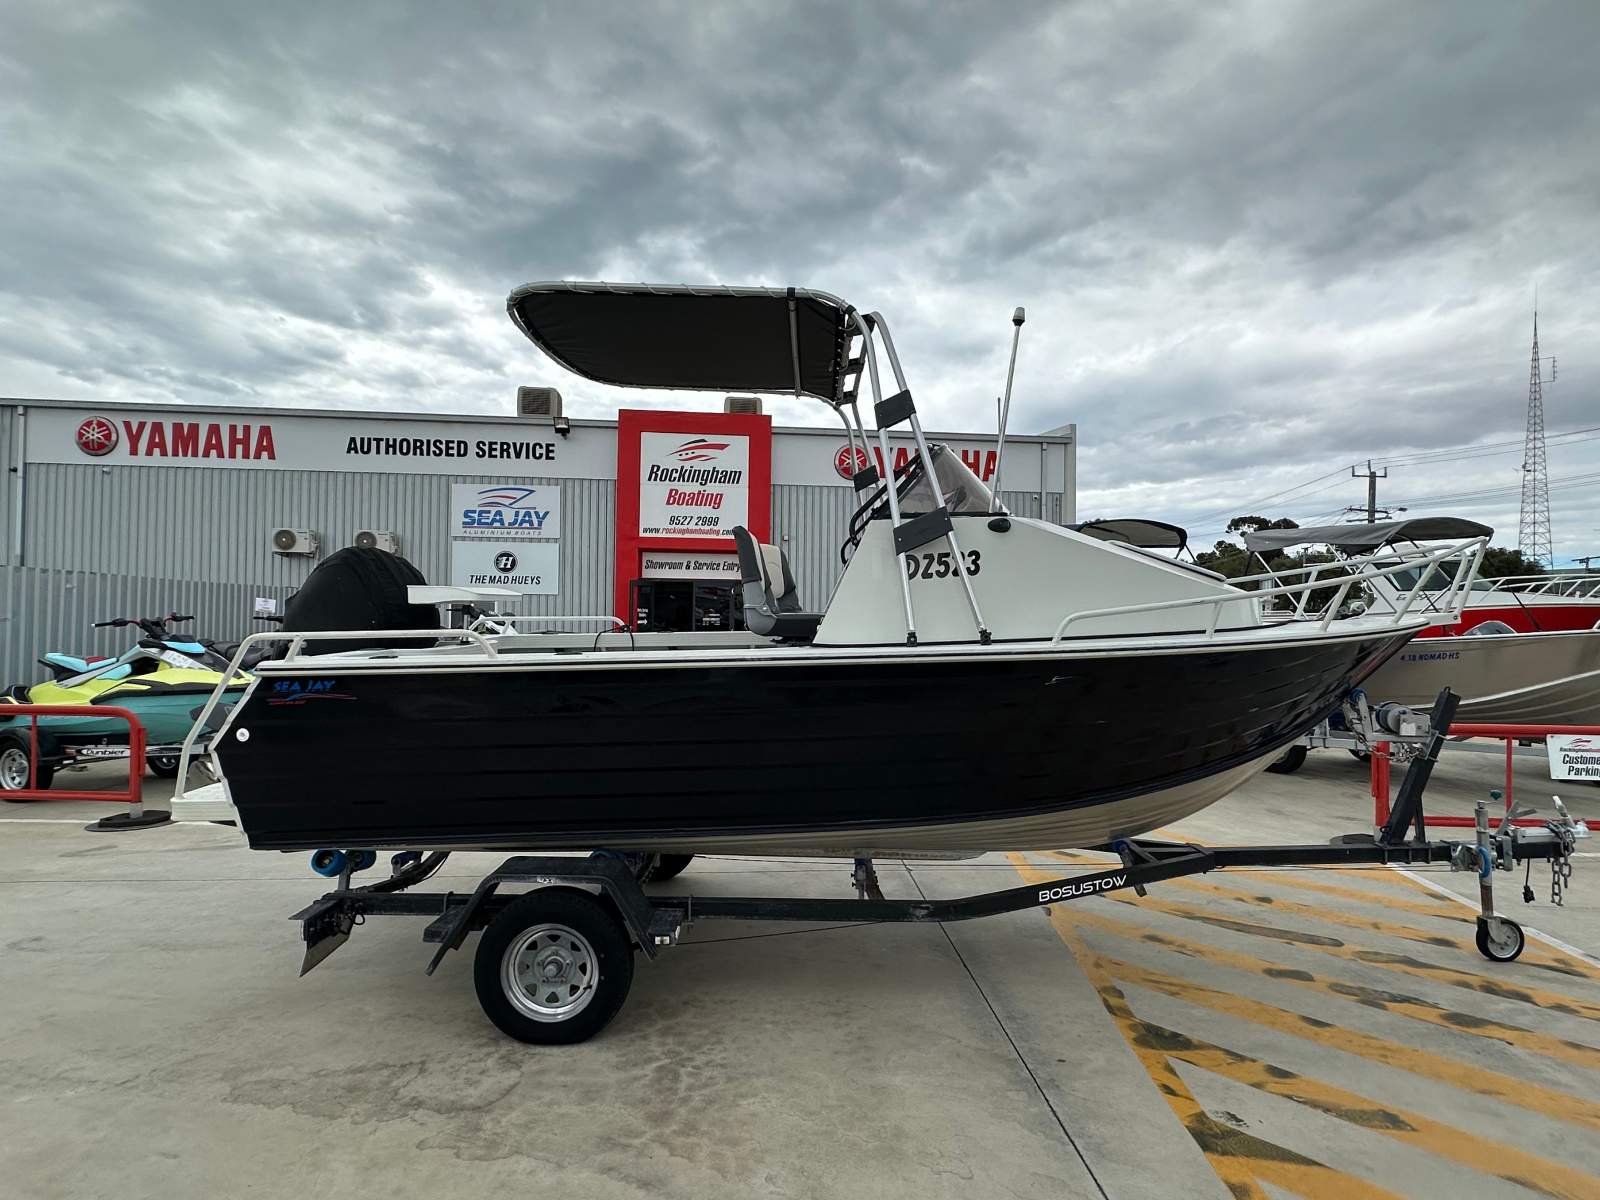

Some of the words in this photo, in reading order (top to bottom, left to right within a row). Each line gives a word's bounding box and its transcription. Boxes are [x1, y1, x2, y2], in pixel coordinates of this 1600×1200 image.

[122, 420, 276, 461] YAMAHA
[346, 437, 469, 458] AUTHORISED
[475, 440, 556, 461] SERVICE
[647, 463, 742, 486] Rockingham
[666, 488, 724, 510] Boating
[462, 509, 505, 527] SEA
[508, 510, 551, 528] JAY
[669, 515, 694, 526] 9527
[695, 516, 720, 527] 2999
[645, 559, 684, 570] Showroom
[685, 560, 691, 570] &
[692, 560, 721, 571] Service
[470, 574, 488, 585] THE
[488, 575, 509, 585] MAD
[510, 575, 542, 586] HUEYS
[1567, 765, 1600, 778] Parkin
[1039, 875, 1127, 902] BOSUSTOW
